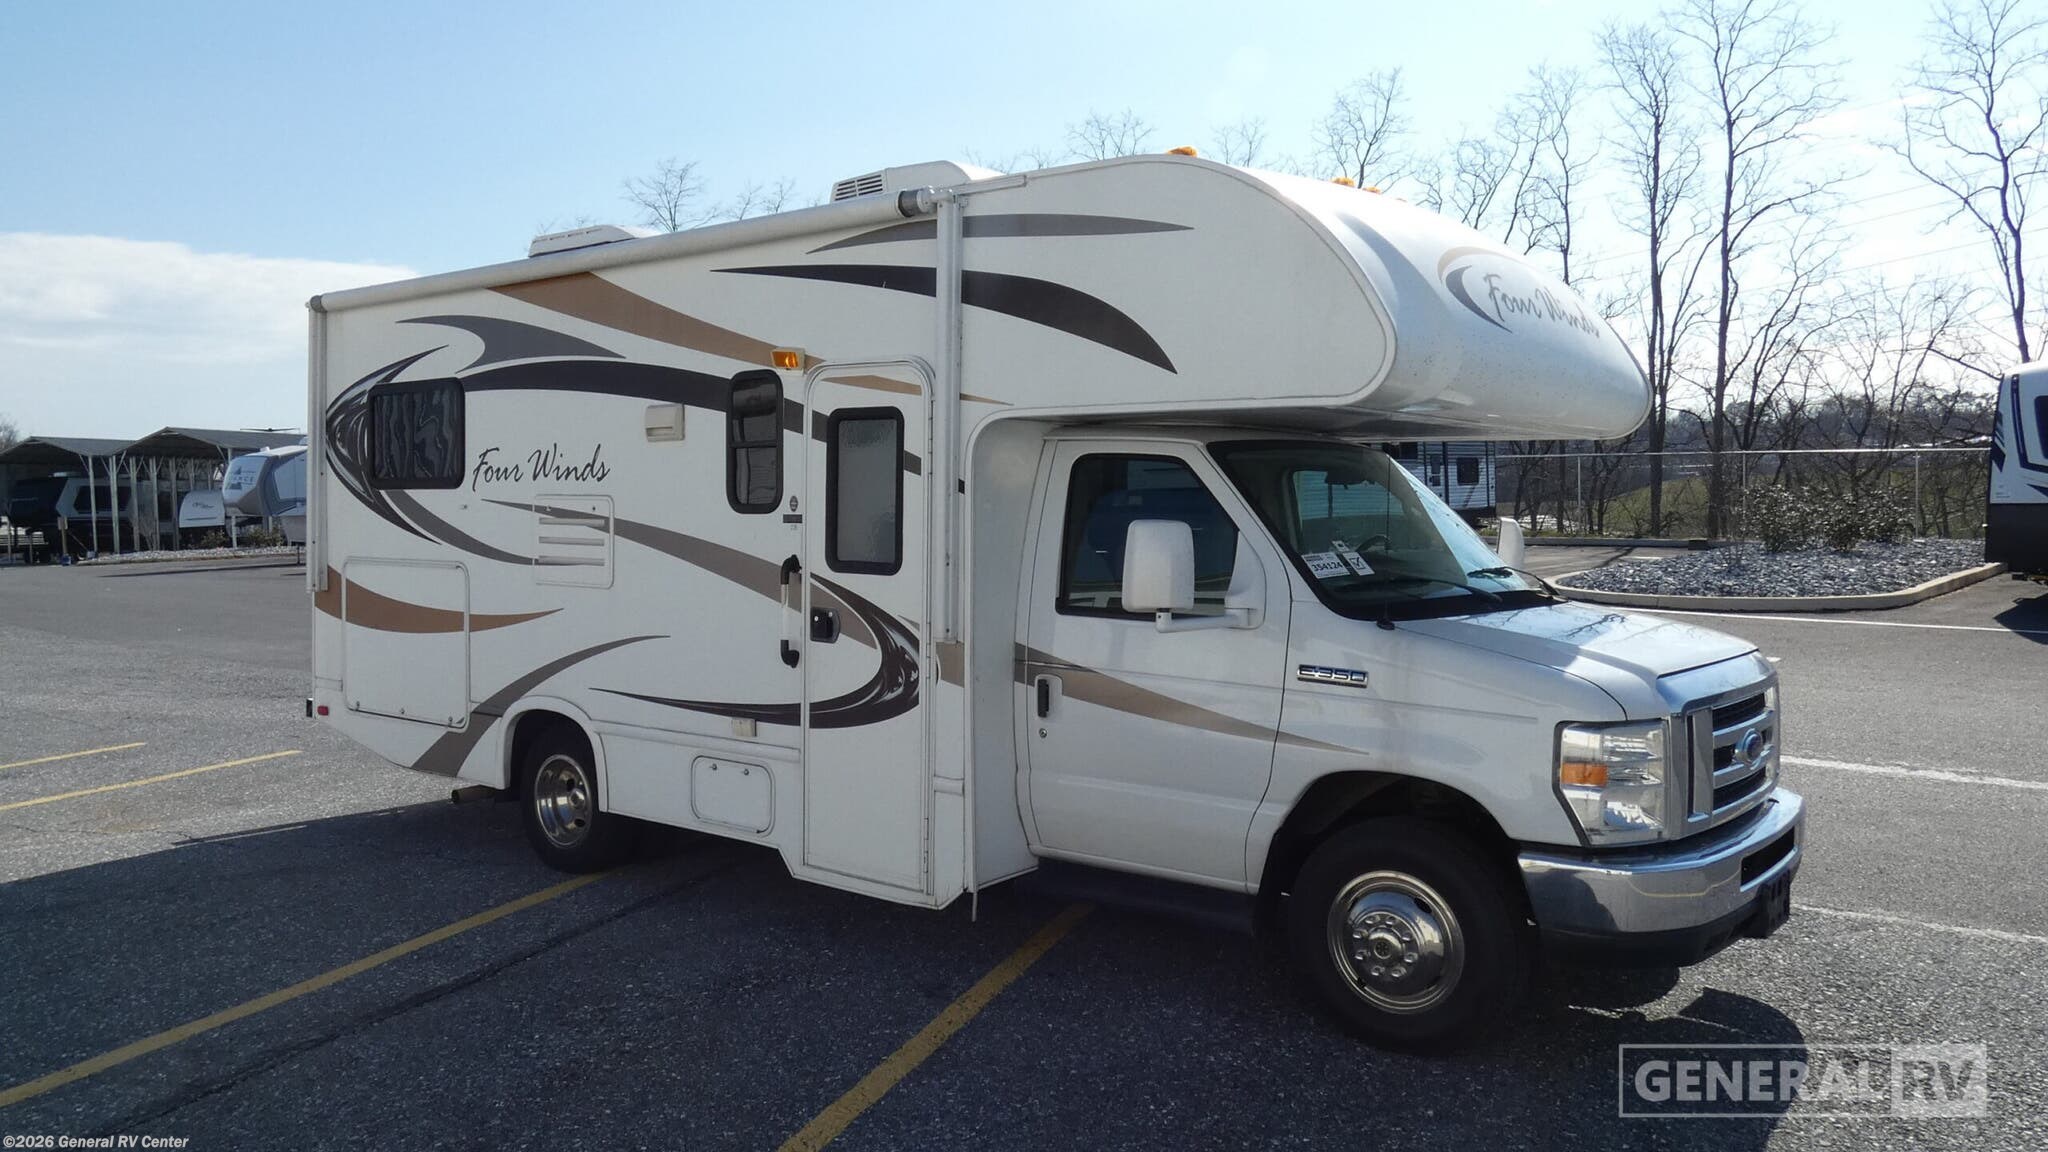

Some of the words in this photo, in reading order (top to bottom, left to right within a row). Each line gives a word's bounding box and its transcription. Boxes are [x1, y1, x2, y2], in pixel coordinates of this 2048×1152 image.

[1482, 272, 1542, 322] Four
[1535, 286, 1600, 338] Winds
[472, 447, 523, 492] Four
[528, 442, 611, 483] Winds
